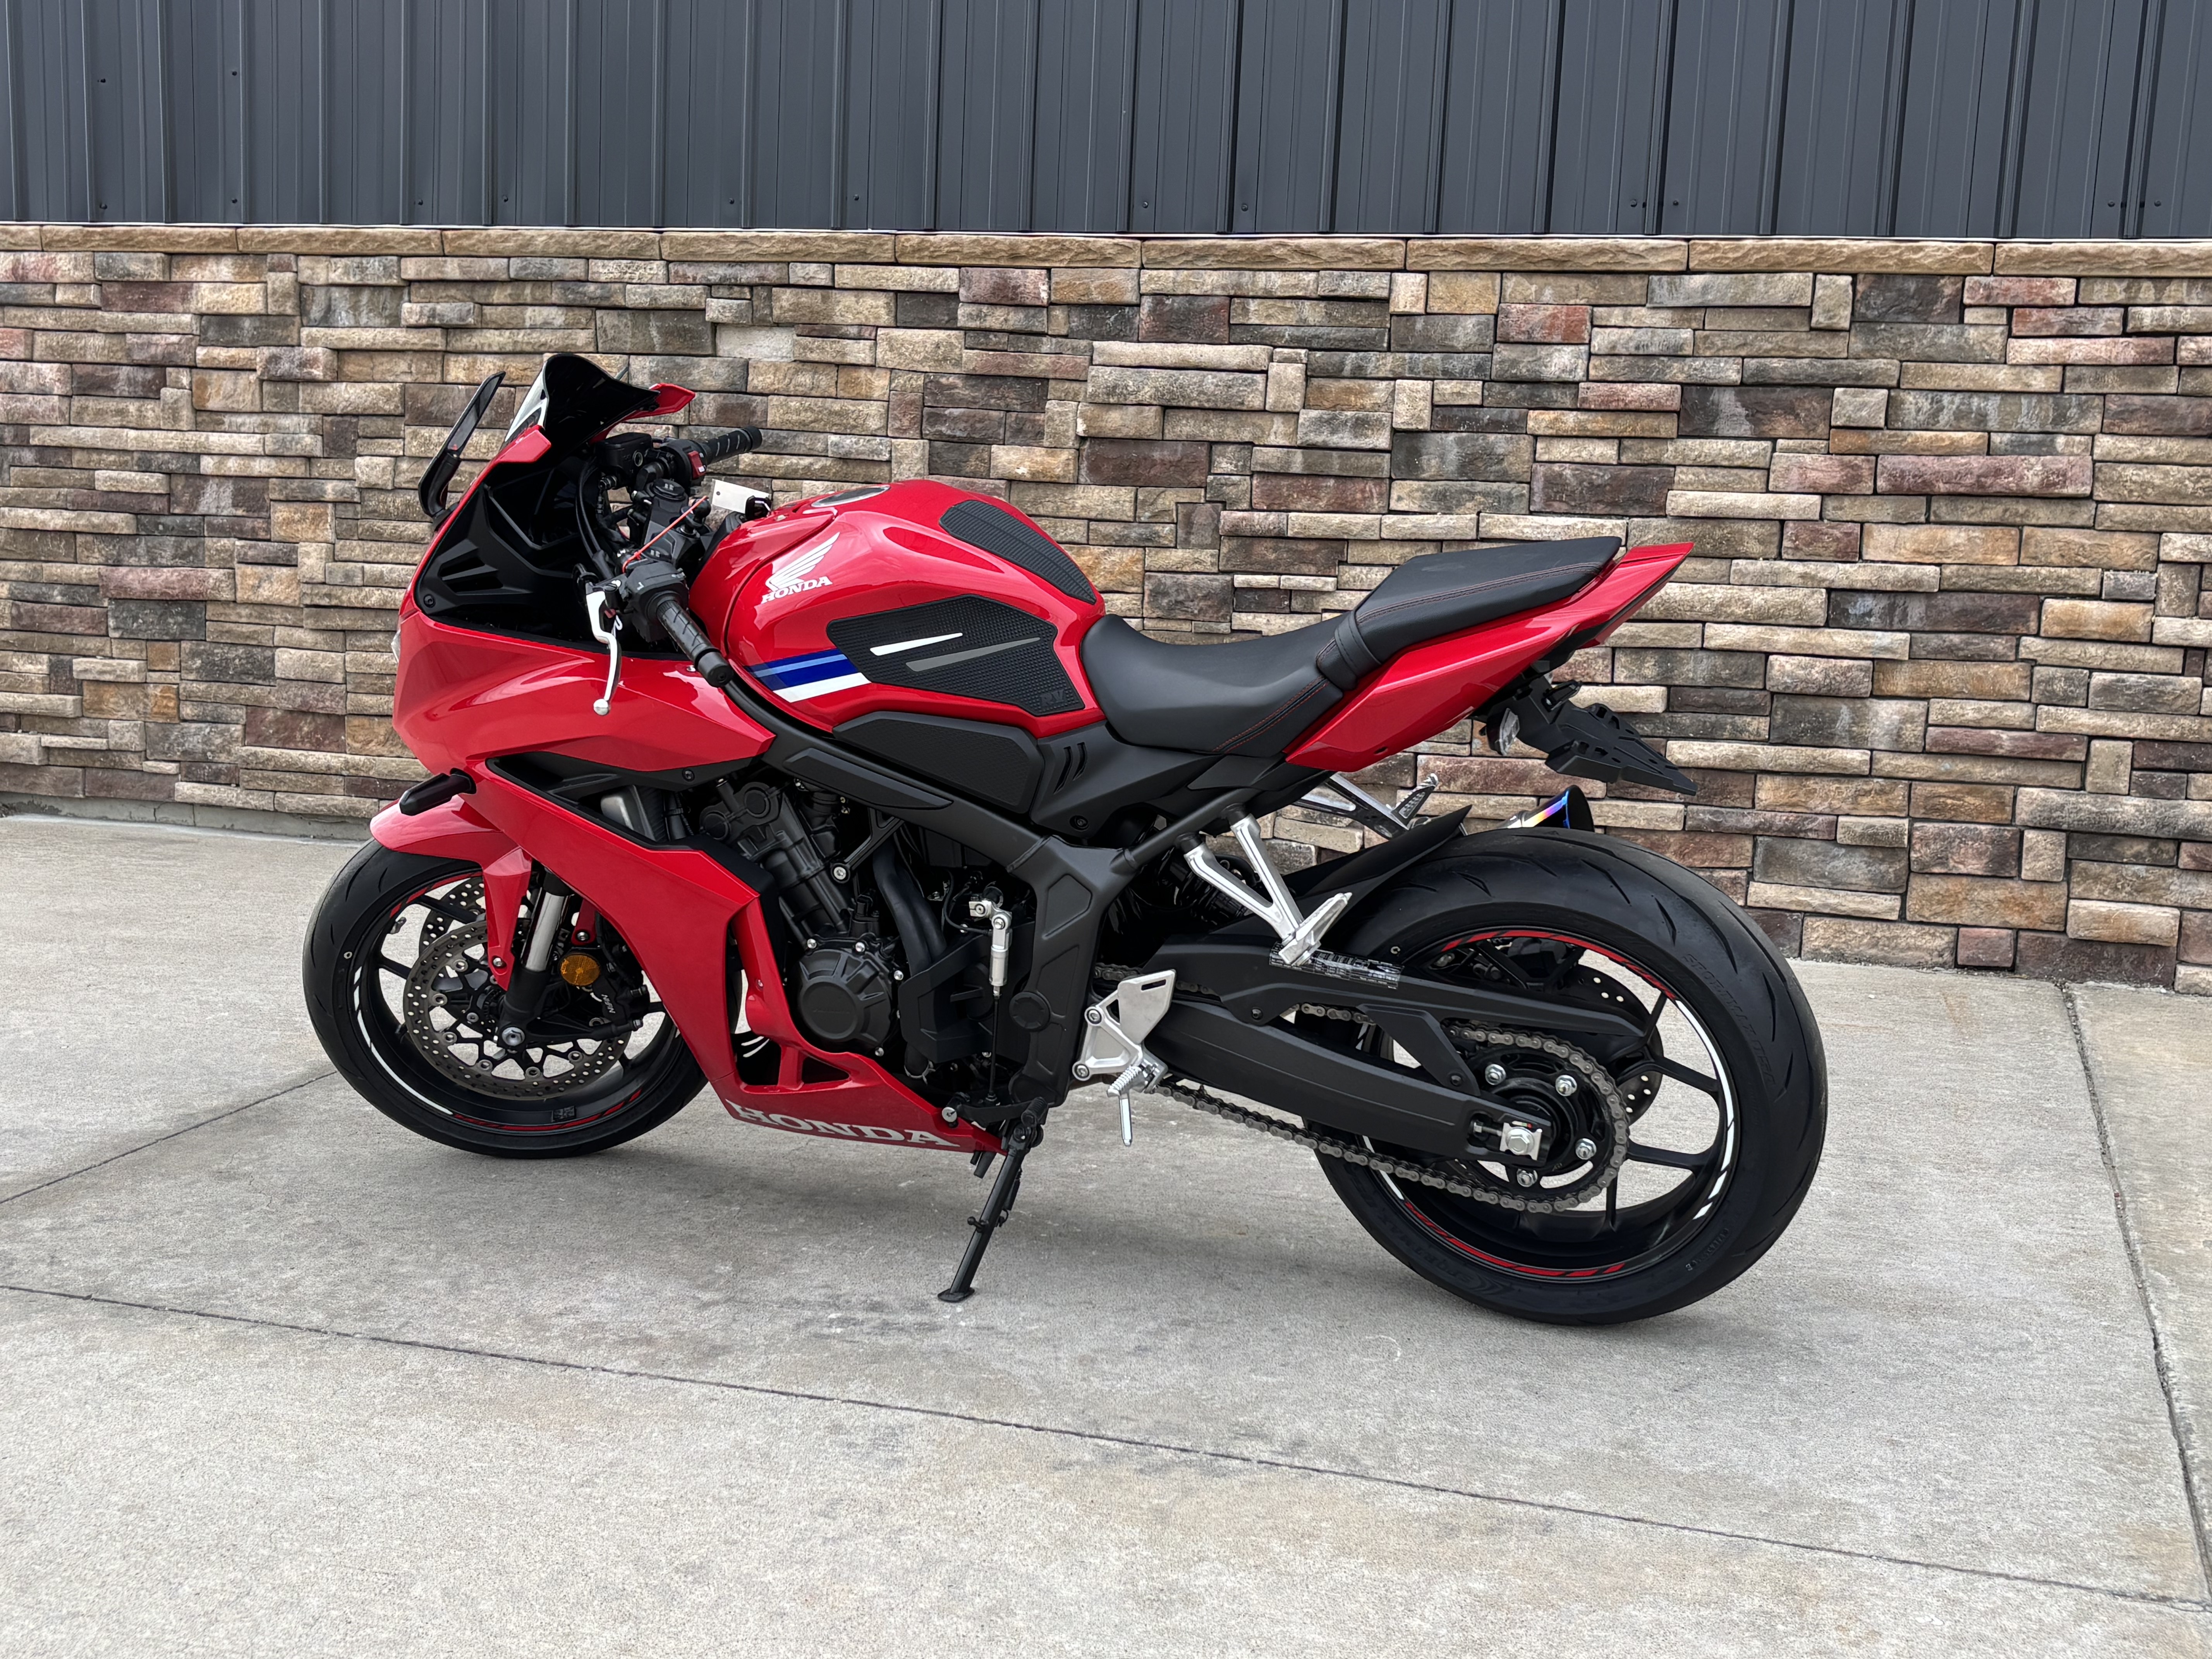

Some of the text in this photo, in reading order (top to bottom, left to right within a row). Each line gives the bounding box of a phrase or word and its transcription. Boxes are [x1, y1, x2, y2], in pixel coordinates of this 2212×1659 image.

[761, 576, 833, 605] HONDA
[1039, 689, 1065, 706] RV
[725, 1099, 960, 1147] HONDA
